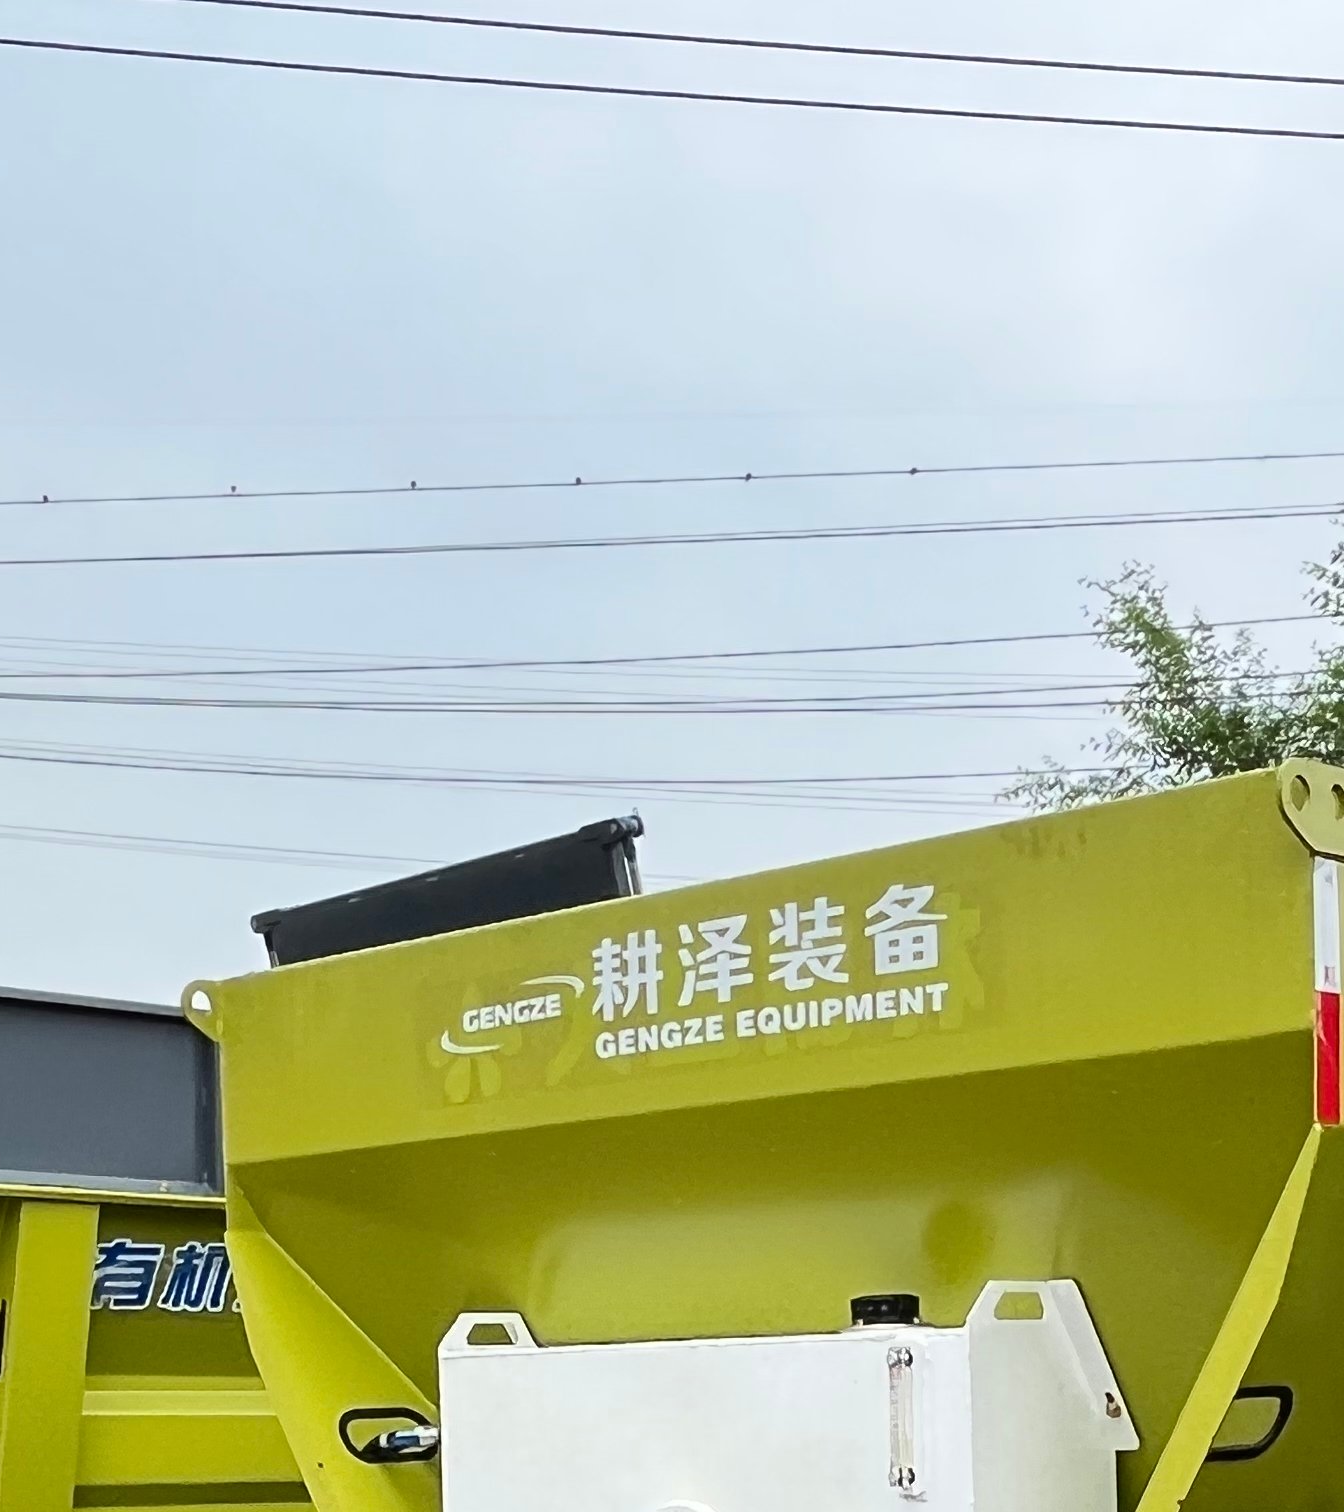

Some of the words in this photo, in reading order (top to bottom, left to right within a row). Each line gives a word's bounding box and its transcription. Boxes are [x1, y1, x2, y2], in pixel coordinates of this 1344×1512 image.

[591, 884, 948, 1022] 耕泽装备
[462, 993, 562, 1034] GENGZE
[595, 1017, 725, 1060] GENGZE
[736, 982, 949, 1038] EQUIPMENT
[90, 1238, 242, 1313] 有机
